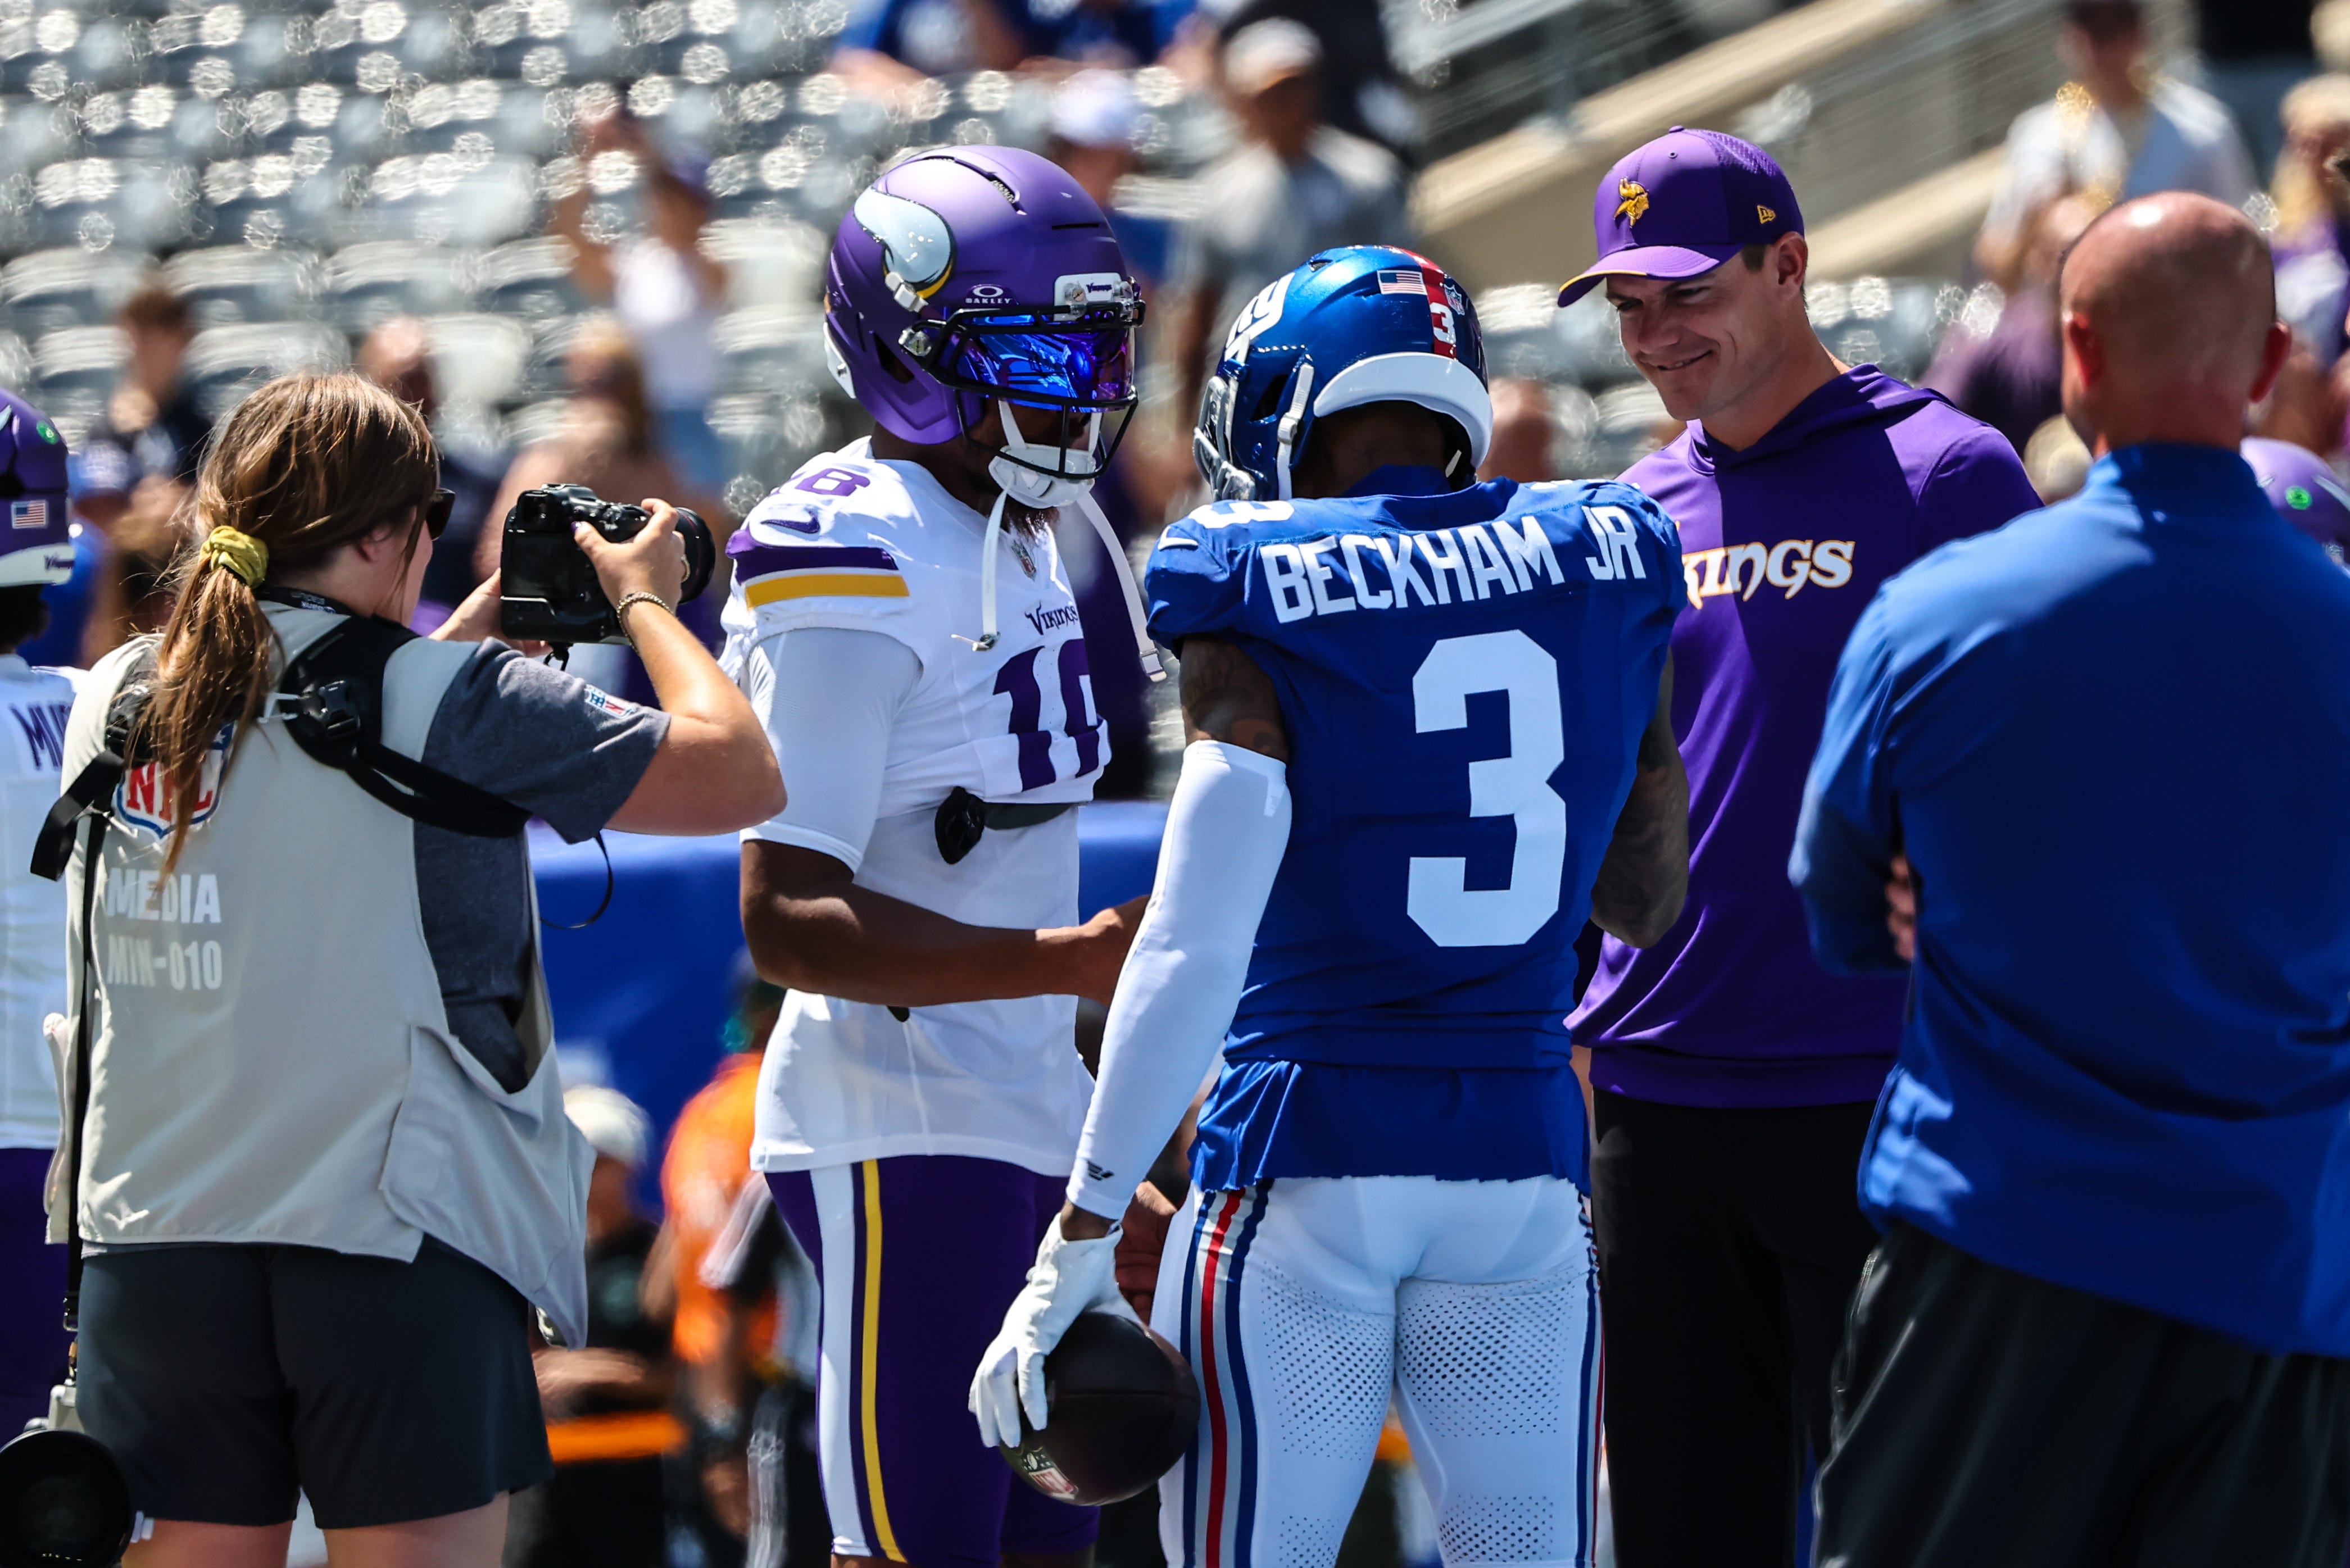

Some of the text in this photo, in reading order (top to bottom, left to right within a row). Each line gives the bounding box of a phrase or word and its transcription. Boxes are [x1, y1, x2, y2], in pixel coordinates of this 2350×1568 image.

[1430, 302, 1457, 344] 3
[768, 467, 870, 497] 8
[1259, 506, 1646, 624] BECKHAM JR
[1681, 539, 1855, 610] KINGS
[1407, 629, 1566, 947] 3
[107, 867, 221, 924] MEDIA
